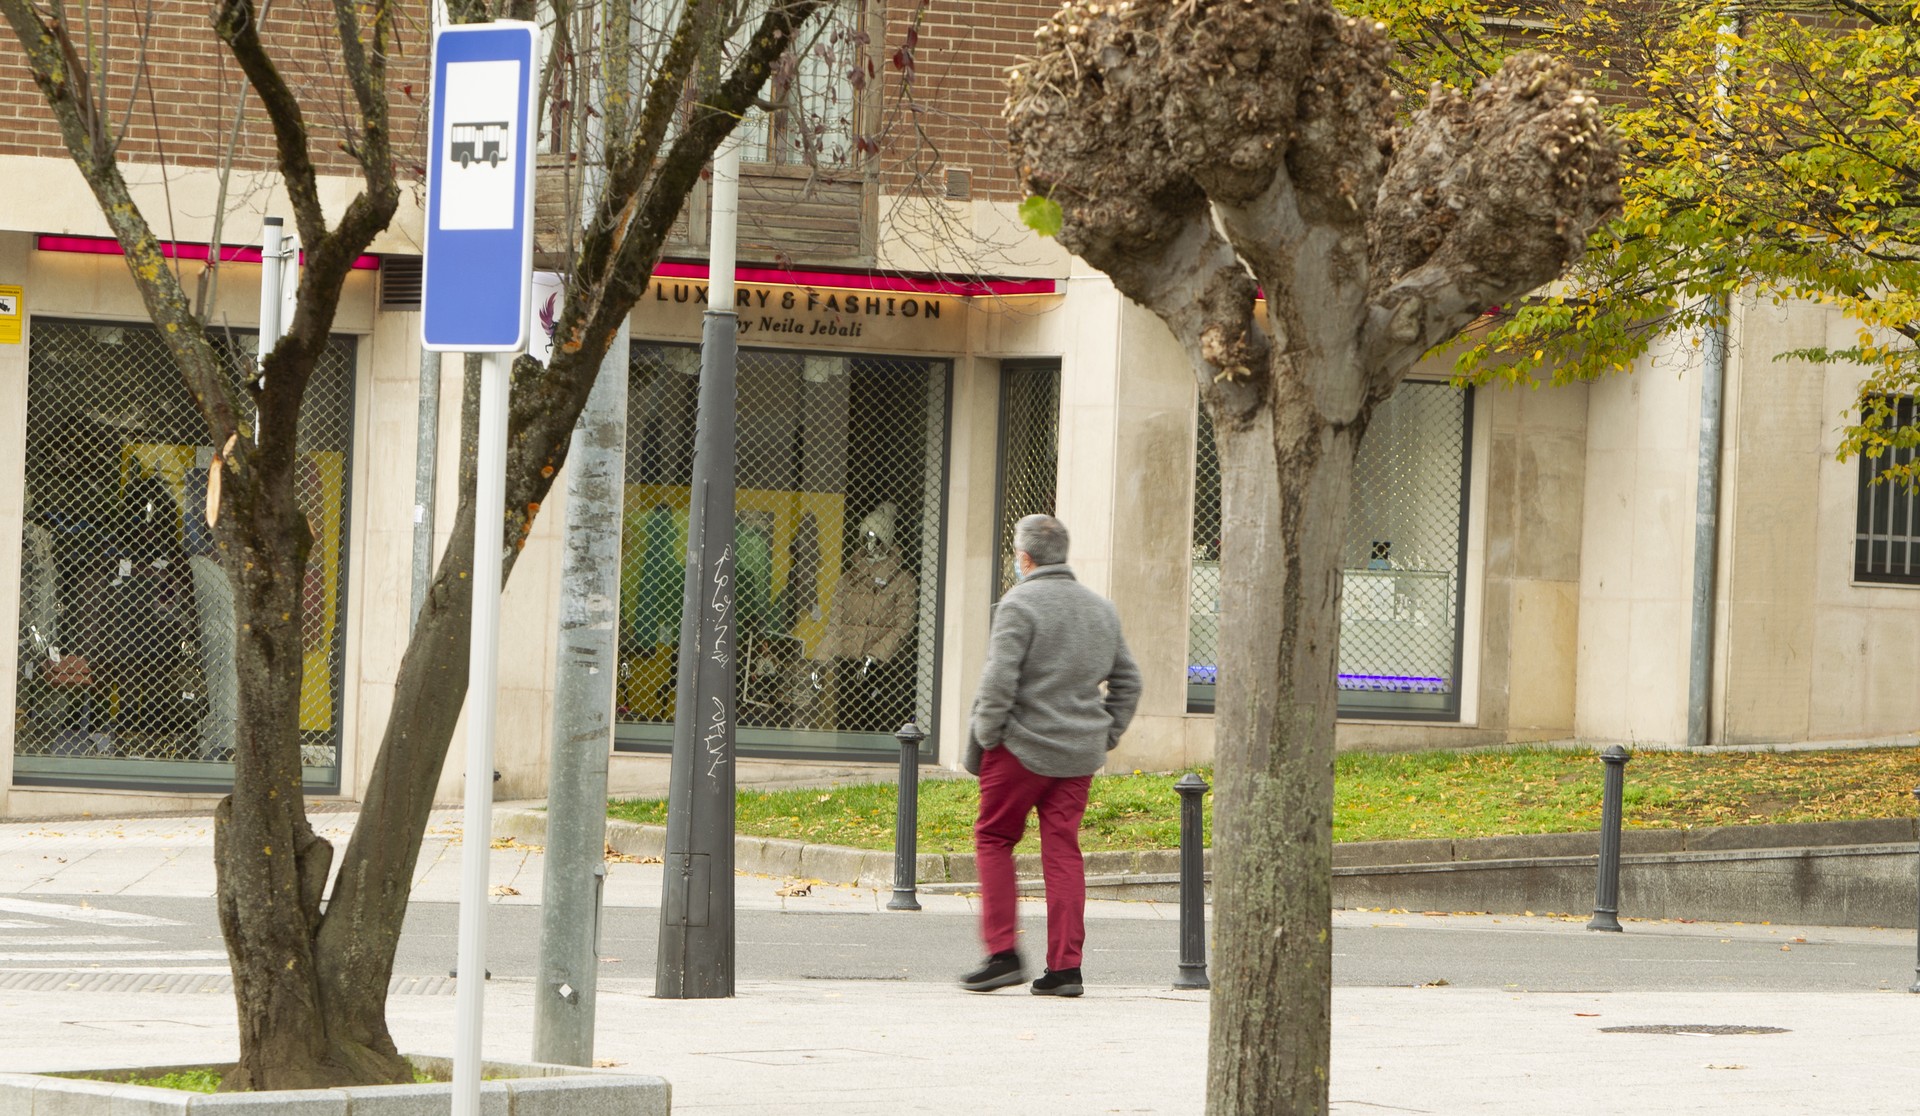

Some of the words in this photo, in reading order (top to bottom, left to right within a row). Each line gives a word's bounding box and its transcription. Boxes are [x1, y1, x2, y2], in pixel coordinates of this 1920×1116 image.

[656, 282, 771, 308] LUXRY
[781, 291, 796, 310] &
[807, 292, 940, 319] FASHION
[758, 317, 804, 334] Neila
[809, 320, 862, 337] Jebali
